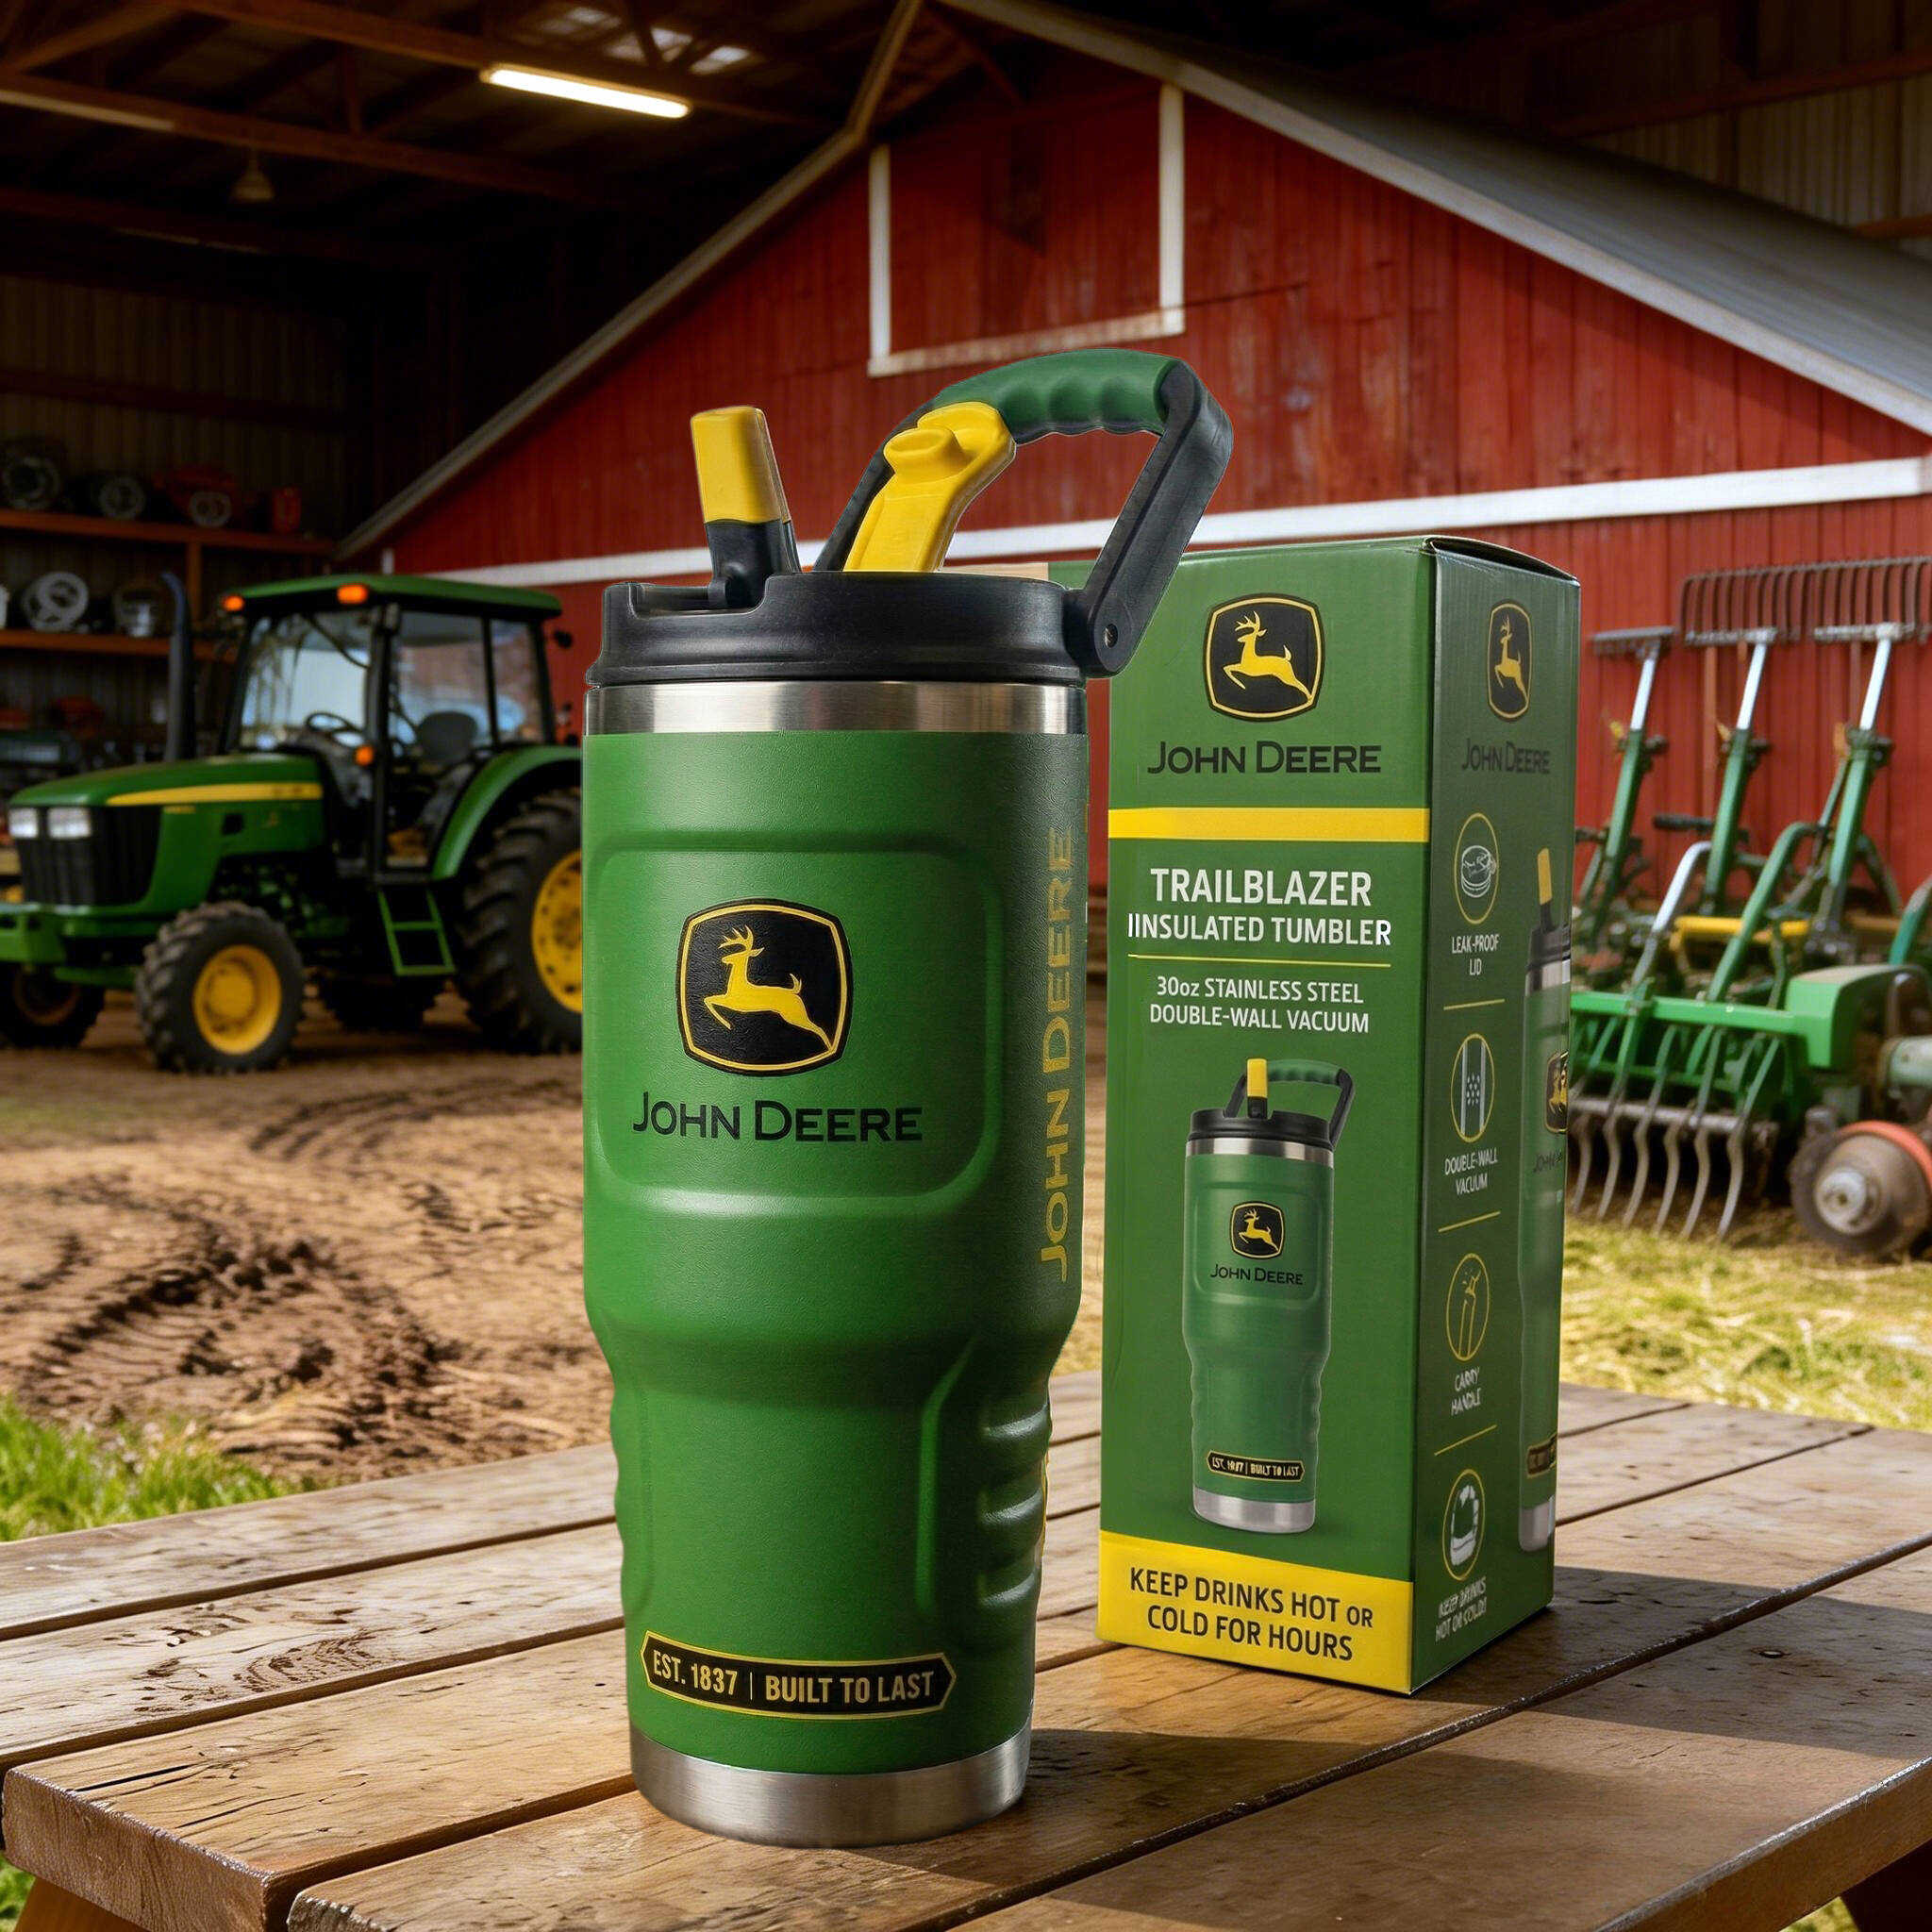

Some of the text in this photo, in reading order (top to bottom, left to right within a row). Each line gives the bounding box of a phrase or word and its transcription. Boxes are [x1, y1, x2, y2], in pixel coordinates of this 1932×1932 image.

[1147, 741, 1382, 774] JOHN DEERE
[1461, 738, 1550, 774] JOHN DEERE
[1150, 868, 1373, 907] TRAILBLAZER
[1271, 917, 1392, 946] TUMBLER
[1469, 958, 1482, 976] LID
[1157, 975, 1365, 1005] 30oz STAINLESS STEEL
[1150, 1004, 1369, 1034] DOUBLE-WALL VACUUM
[1041, 826, 1073, 1283] JOHN DEERE
[633, 1091, 924, 1142] JOHN DEERE
[1210, 1263, 1304, 1285] JOHN DEERE
[1130, 1566, 1374, 1628] KEEP DRINKS HOT OR
[1147, 1605, 1353, 1662] COLD FOR HOURS
[653, 1649, 935, 1705] EST. 1837 BUILT TO LAST
